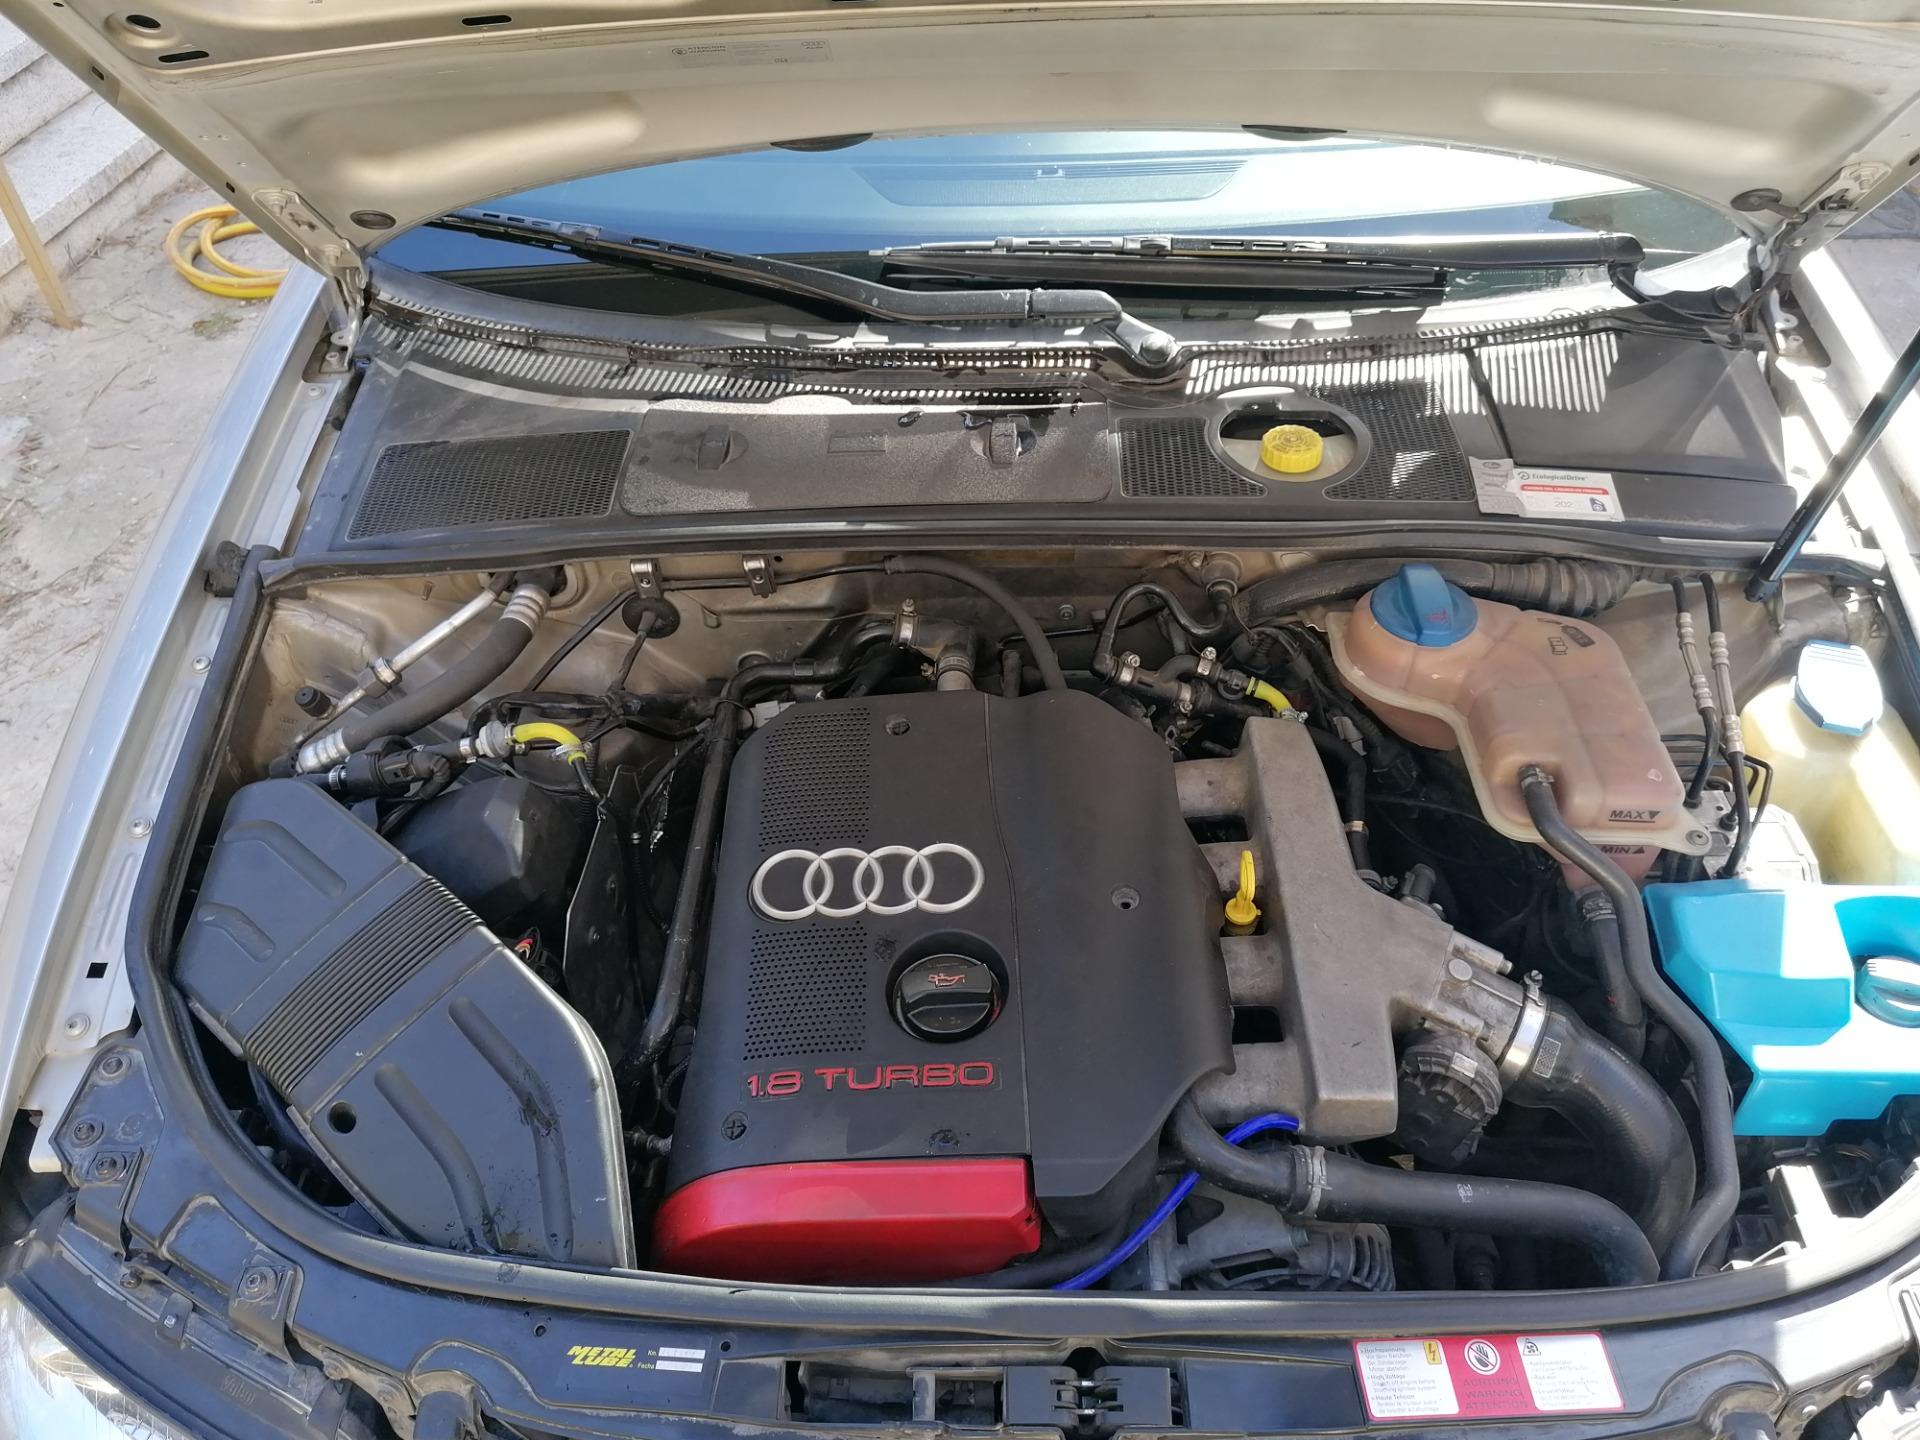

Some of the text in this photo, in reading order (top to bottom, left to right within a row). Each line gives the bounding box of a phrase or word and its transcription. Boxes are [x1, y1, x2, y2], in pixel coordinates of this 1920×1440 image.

[1610, 810, 1646, 819] MAX
[1601, 846, 1631, 854] MIN
[747, 1061, 995, 1097] 1.8 TURBO
[567, 1345, 637, 1358] METAL
[571, 1354, 635, 1367] LUBE
